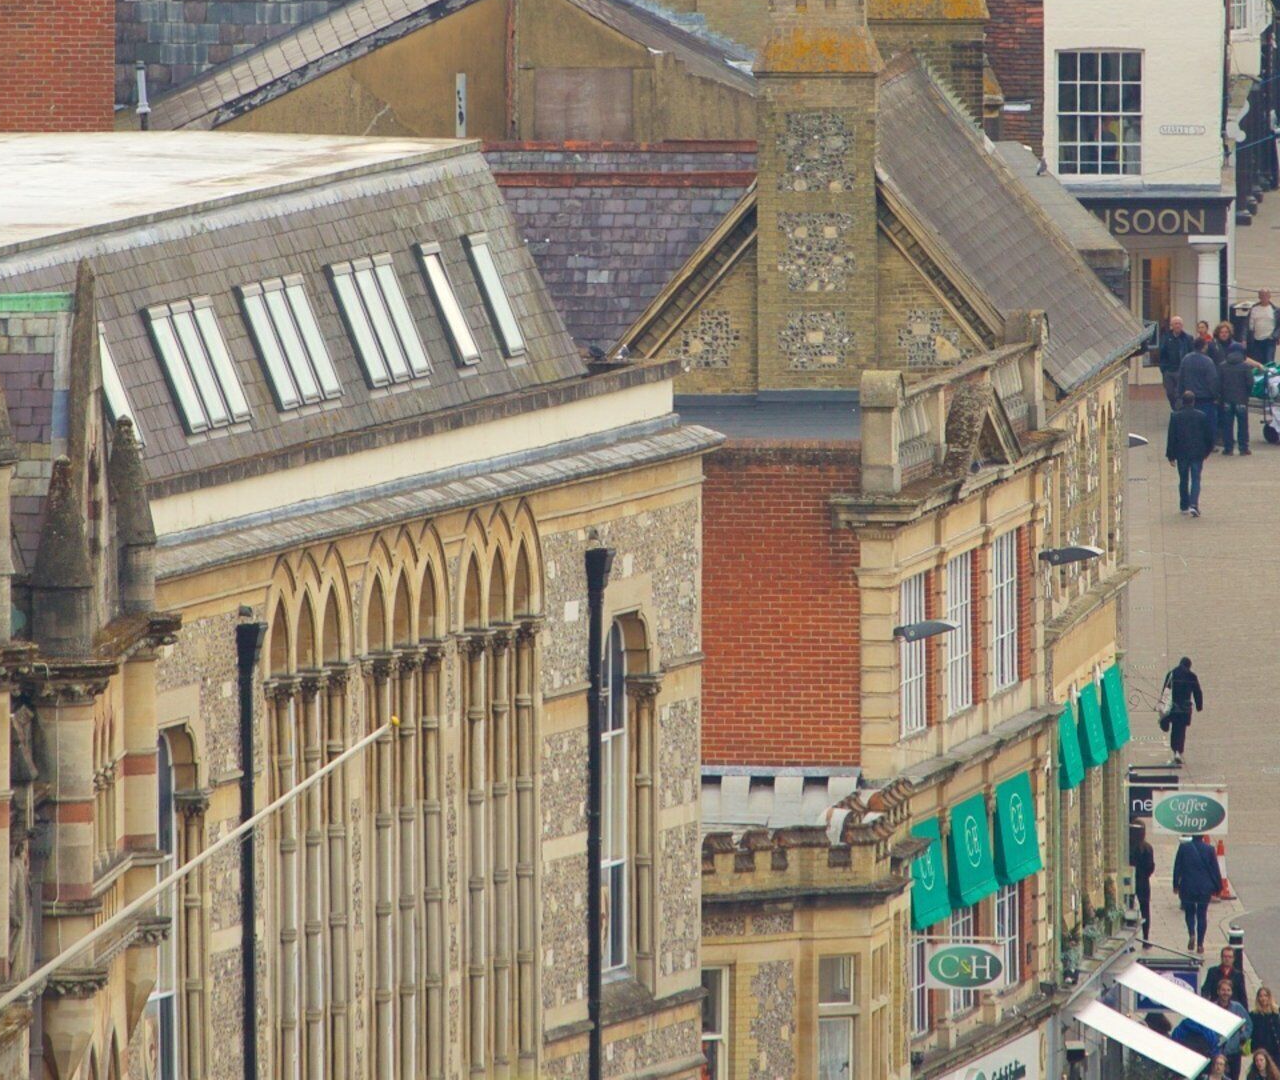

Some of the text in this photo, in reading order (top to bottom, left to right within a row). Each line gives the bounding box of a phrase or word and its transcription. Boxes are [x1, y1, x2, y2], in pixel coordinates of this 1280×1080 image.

[1169, 798, 1208, 814] Coffee
[1176, 814, 1208, 830] Shop
[938, 954, 993, 980] C&H
